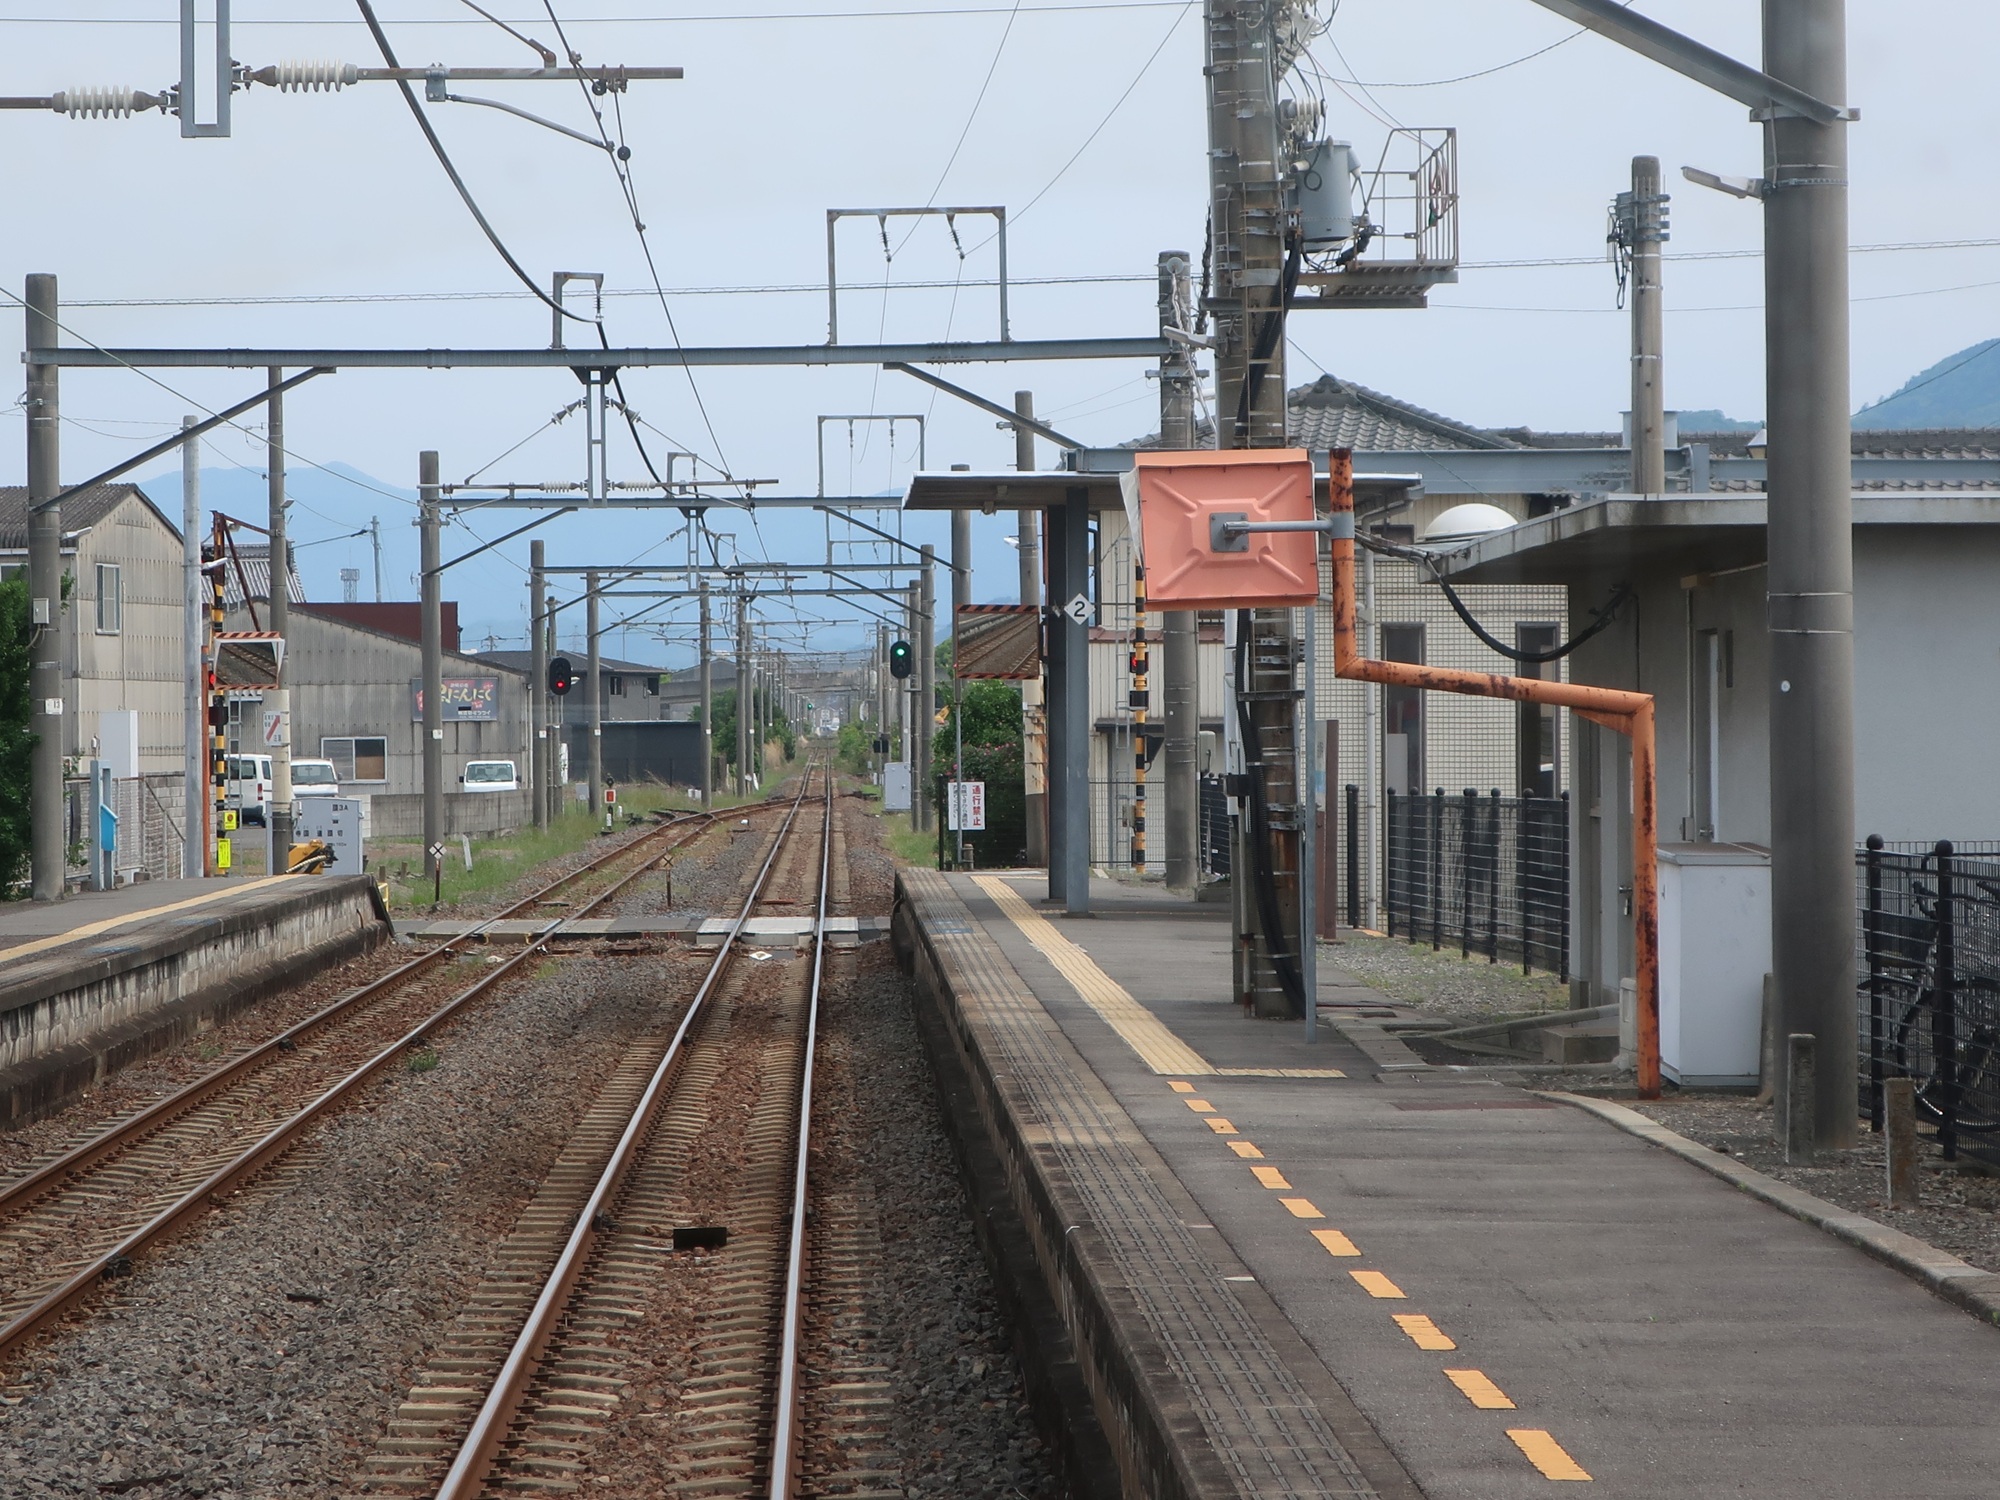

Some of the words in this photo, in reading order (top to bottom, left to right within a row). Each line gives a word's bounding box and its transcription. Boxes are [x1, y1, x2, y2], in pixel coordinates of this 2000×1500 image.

[1074, 601, 1085, 617] 2
[972, 785, 981, 826] 通行禁止
